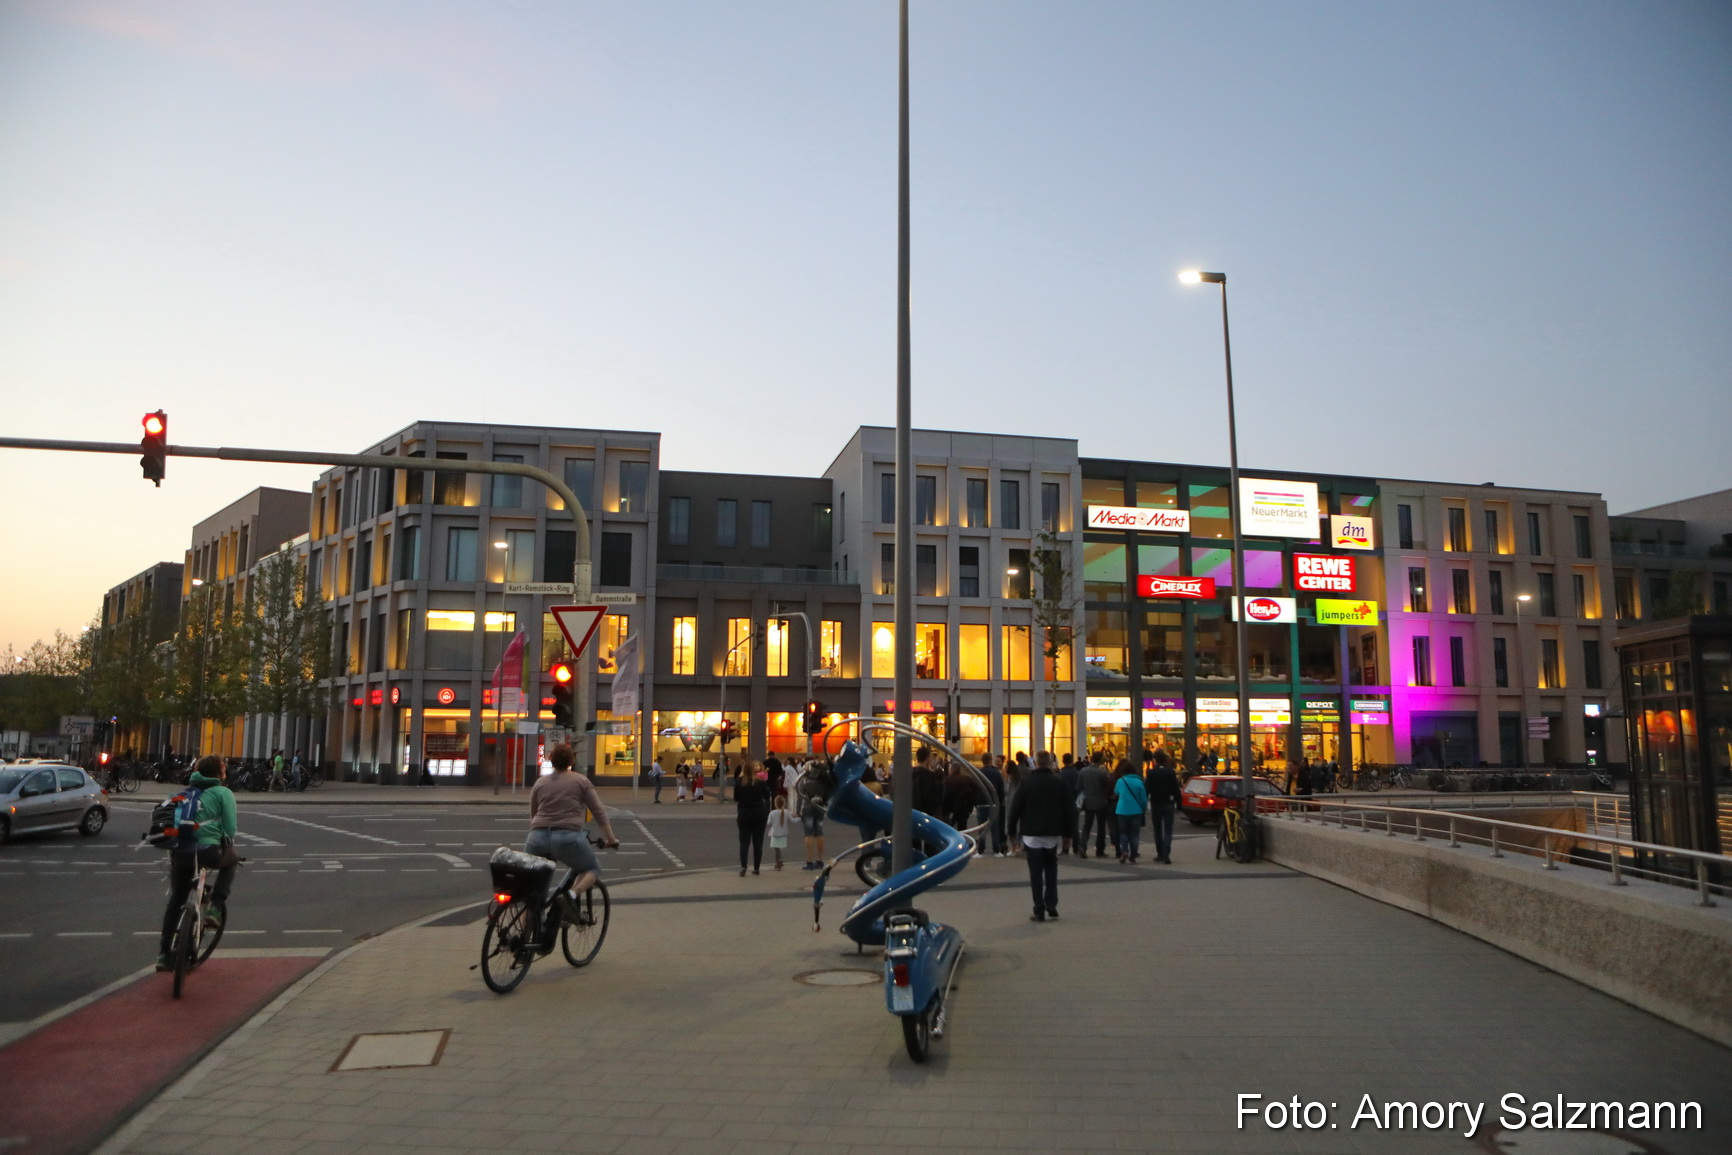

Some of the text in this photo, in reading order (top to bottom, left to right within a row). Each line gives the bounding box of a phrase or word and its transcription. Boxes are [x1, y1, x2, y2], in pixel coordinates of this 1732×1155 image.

[1091, 509, 1186, 528] Media Markt
[1251, 506, 1308, 519] NeuerMarkt
[1342, 521, 1365, 537] dm
[1298, 556, 1352, 576] REWE
[1150, 580, 1202, 594] CINEPLEX
[1298, 575, 1352, 591] CENTER
[595, 594, 633, 603] Dammstraße
[1249, 602, 1280, 617] Hervis
[1320, 609, 1359, 622] jumpers
[1202, 699, 1232, 707] GameStop
[1305, 701, 1335, 709] DEPOT
